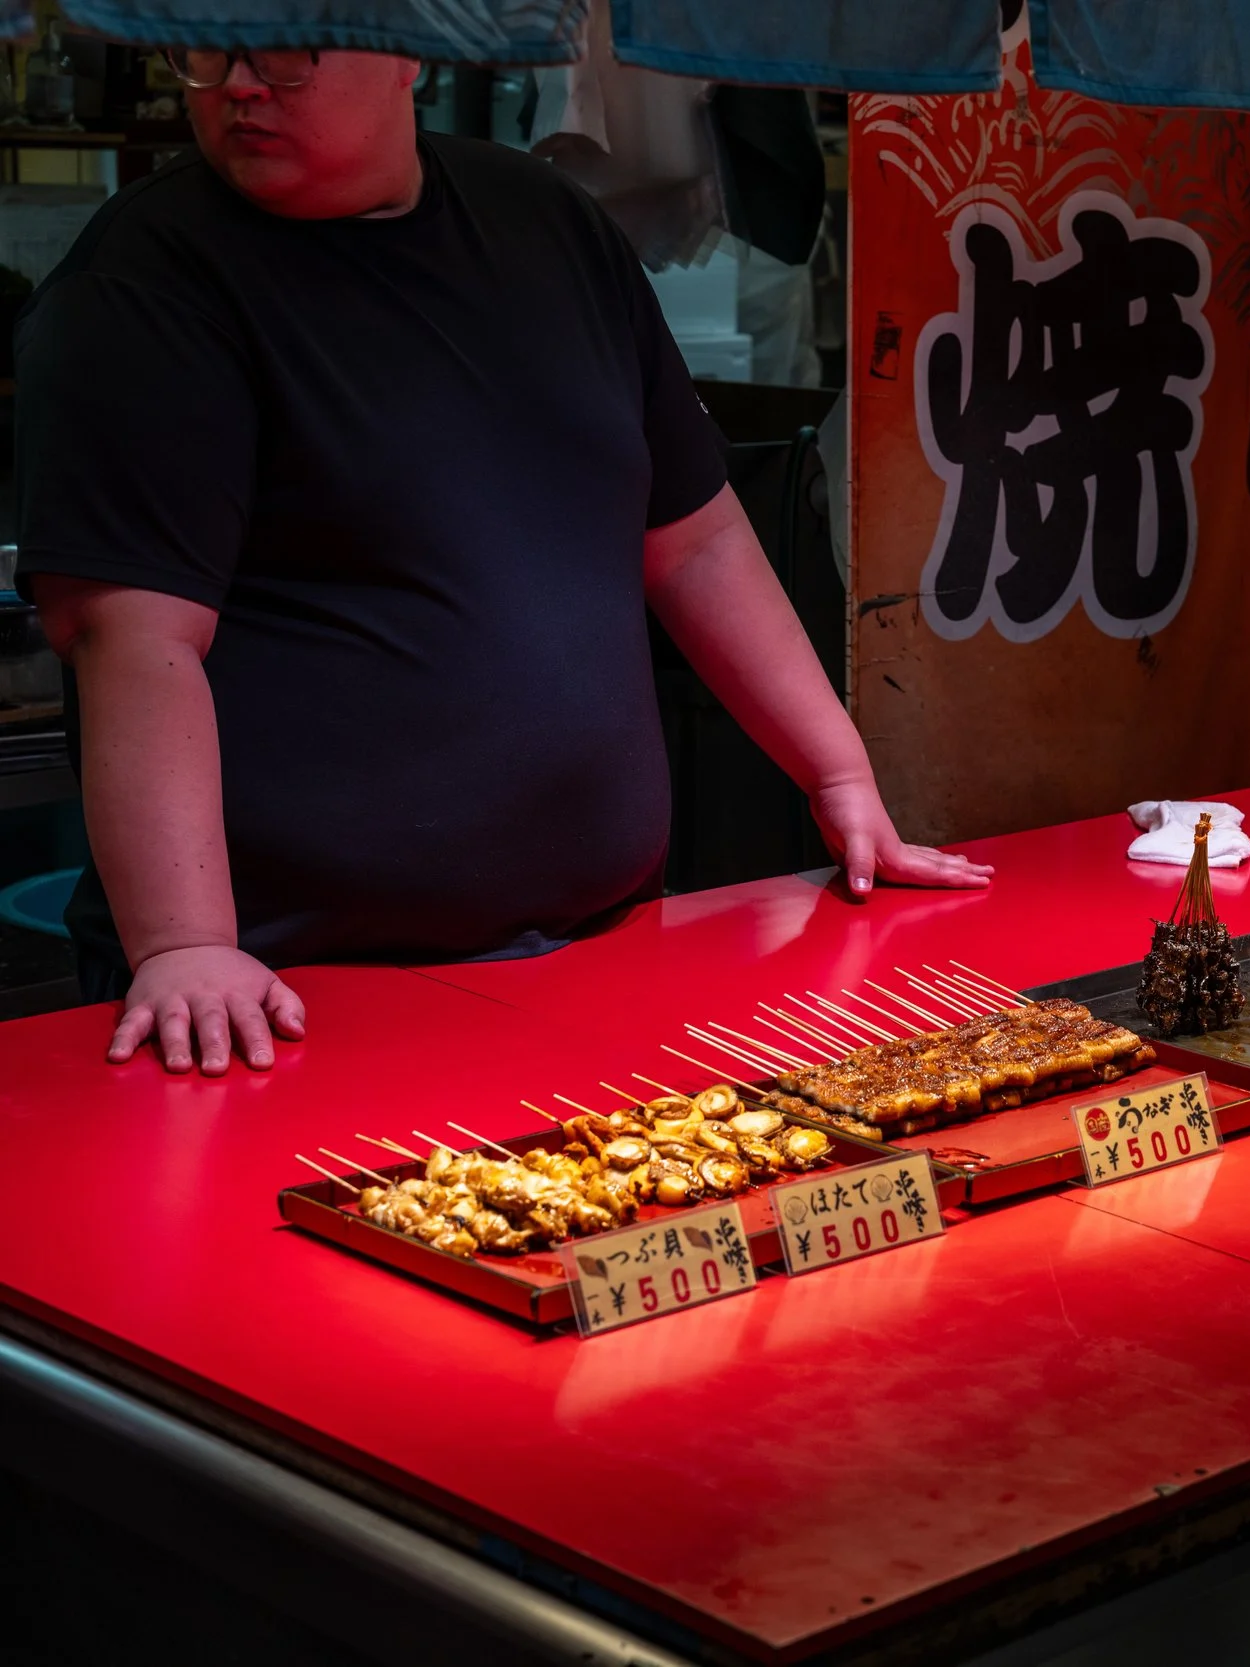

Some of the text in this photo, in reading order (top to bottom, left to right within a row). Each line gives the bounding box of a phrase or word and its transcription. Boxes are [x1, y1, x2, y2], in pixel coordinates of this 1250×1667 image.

[923, 200, 1210, 633] 焼
[1116, 1093, 1175, 1134] うなぎ
[1179, 1082, 1210, 1145] 串焼き
[1106, 1124, 1191, 1171] ¥500
[810, 1169, 928, 1233] ほたて 串焼き
[607, 1216, 750, 1284] つぶ貝 串焼き
[795, 1209, 900, 1262] ¥500
[609, 1259, 721, 1317] ¥500
